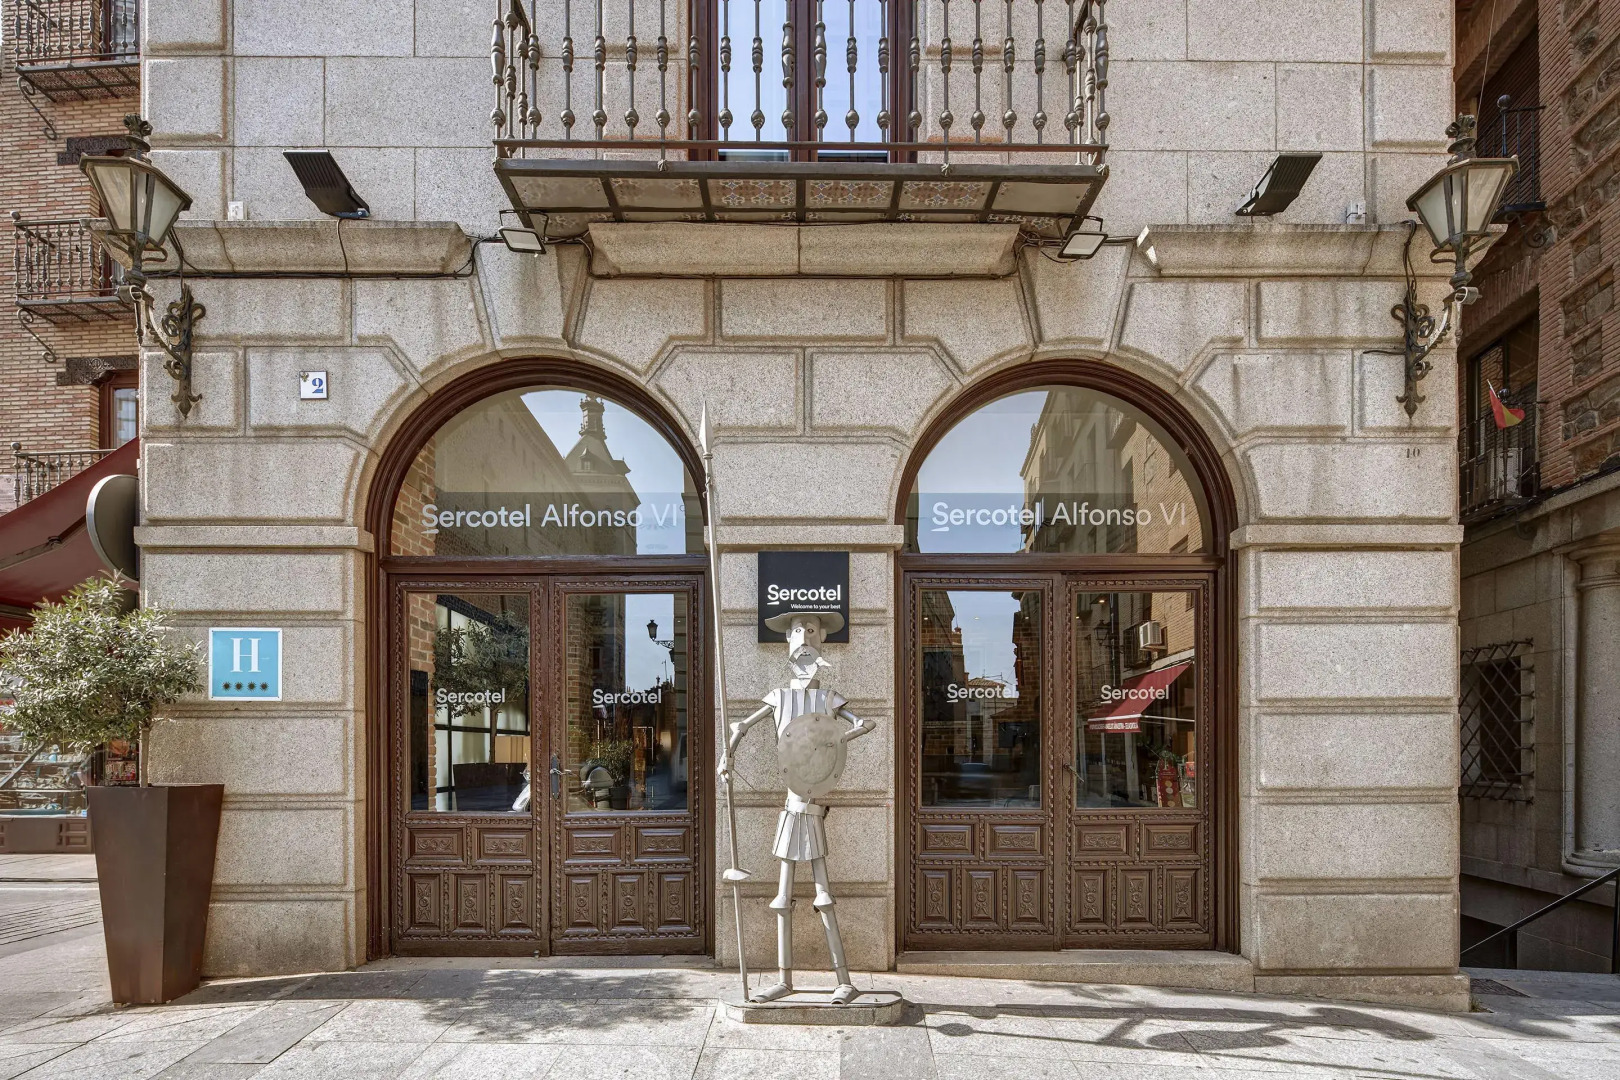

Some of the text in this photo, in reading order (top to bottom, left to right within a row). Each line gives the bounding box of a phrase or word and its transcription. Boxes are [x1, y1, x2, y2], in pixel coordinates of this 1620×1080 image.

[311, 377, 324, 394] 2
[421, 503, 678, 534] Sercotel Alfonso VI
[931, 501, 1187, 532] Sercotel Alfonso VI
[767, 584, 841, 605] Sercotel
[230, 637, 262, 673] H
[436, 688, 506, 708] Sercotel
[592, 689, 662, 709] Sercotel
[946, 683, 1017, 703] Sercotel
[1100, 684, 1169, 704] Sercotel
